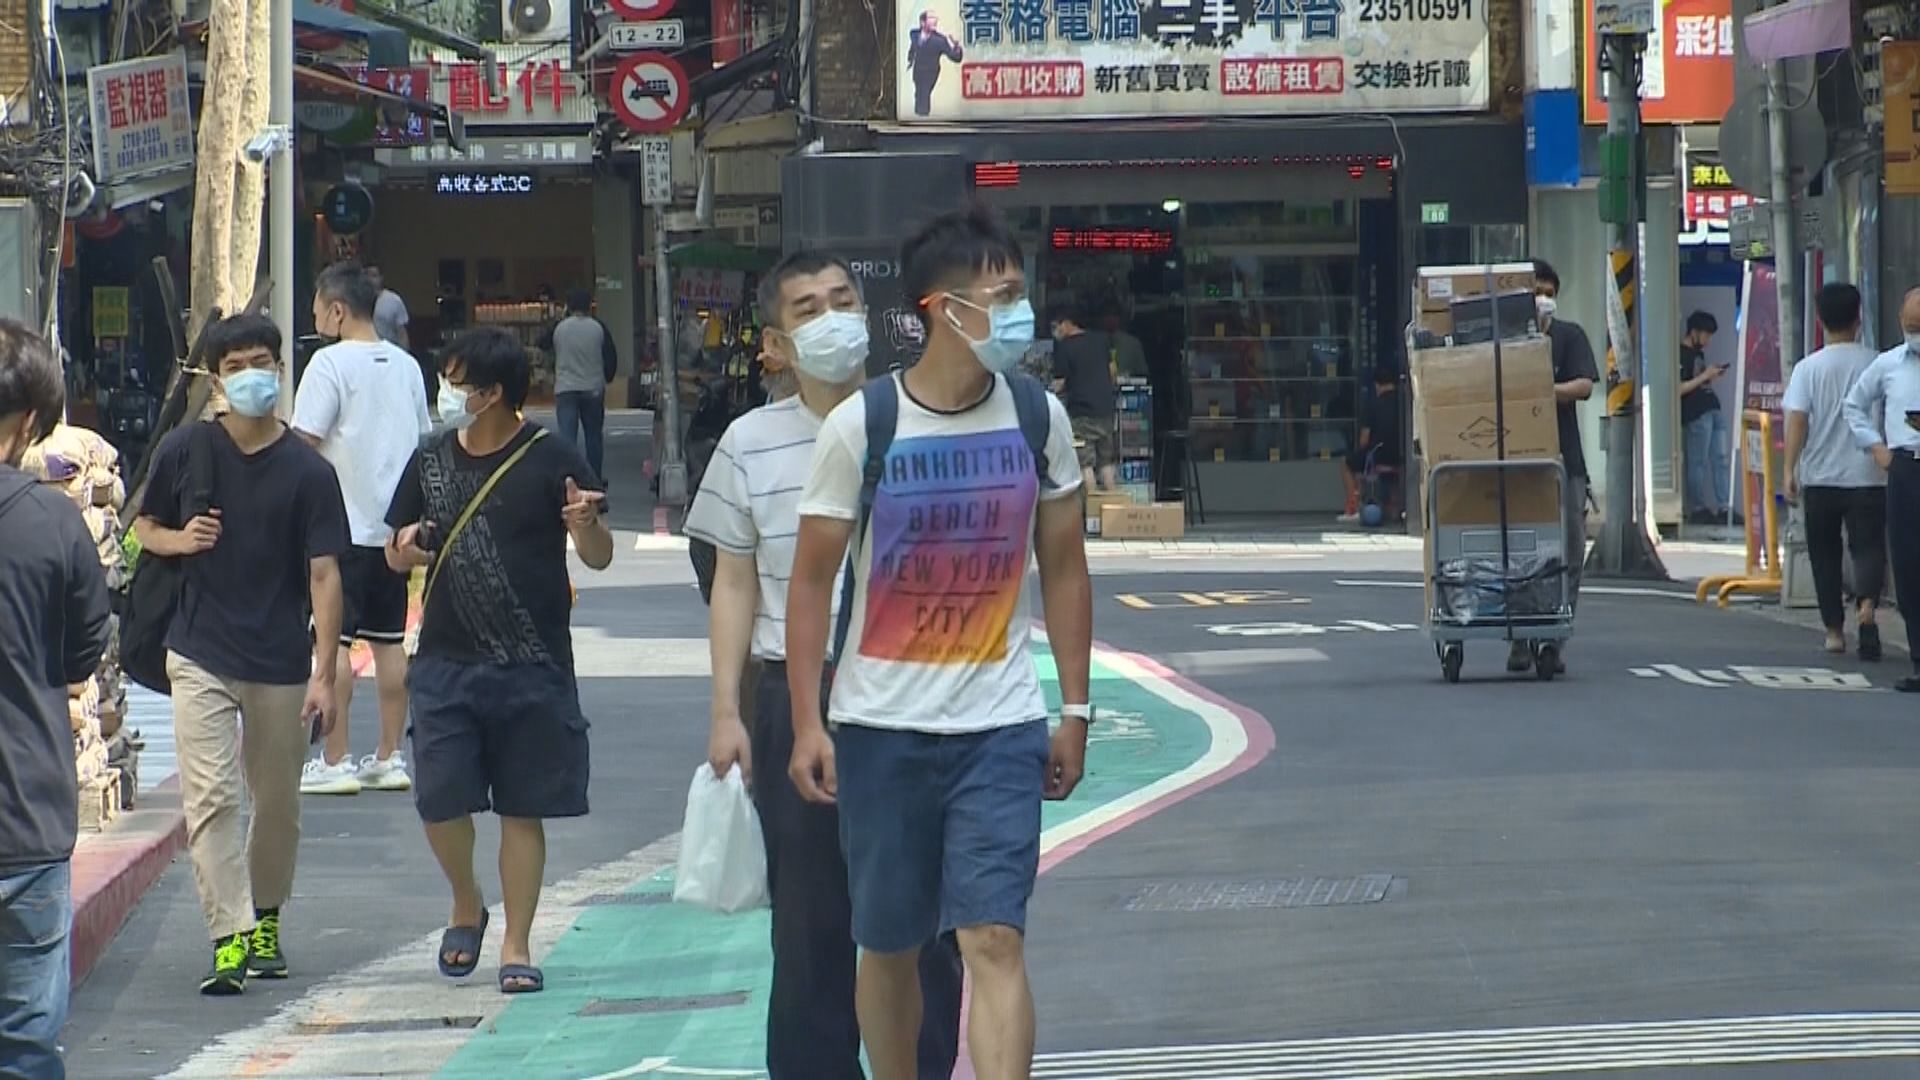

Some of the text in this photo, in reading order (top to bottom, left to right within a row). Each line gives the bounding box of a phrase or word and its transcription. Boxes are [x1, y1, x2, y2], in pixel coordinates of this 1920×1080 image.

[1360, 0, 1472, 21] 23510591
[966, 59, 1471, 96] 高價收購 新舊買賣 設備租賃 交換折讓
[106, 68, 167, 129] 監視器
[908, 500, 1000, 532] BEACH
[881, 552, 1016, 582] NEW YORK
[916, 605, 974, 633] CITY
